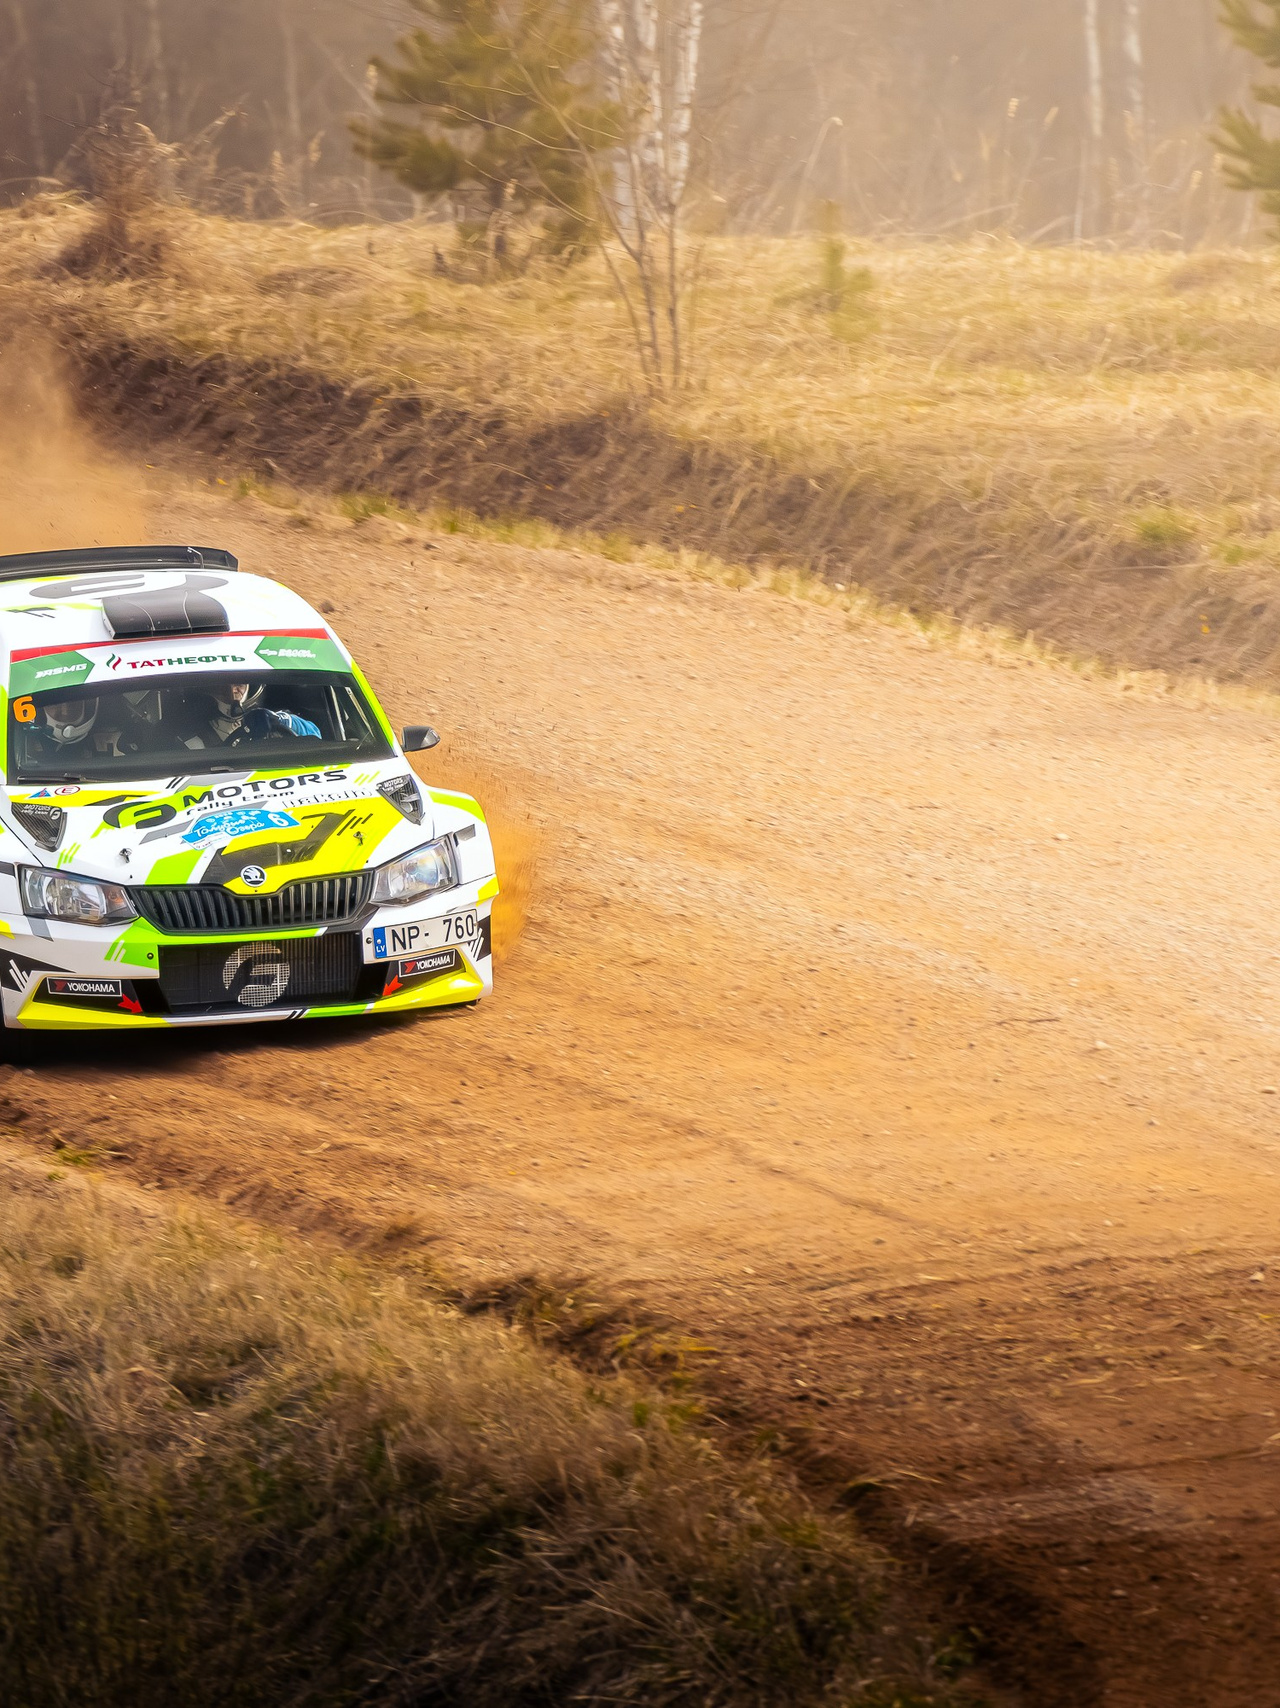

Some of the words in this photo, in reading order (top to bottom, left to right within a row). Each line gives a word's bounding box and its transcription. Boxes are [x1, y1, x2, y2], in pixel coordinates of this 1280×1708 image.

[126, 654, 246, 670] ТАТНЕФТЬ
[13, 695, 37, 723] 6
[183, 769, 348, 808] MOTORS
[186, 799, 234, 816] rally
[241, 790, 295, 802] team
[267, 813, 290, 827] 6
[442, 914, 475, 942] 760
[375, 945, 386, 953] LV
[415, 954, 451, 970] YOKOHAMA
[67, 981, 115, 993] YOKOHAMA
